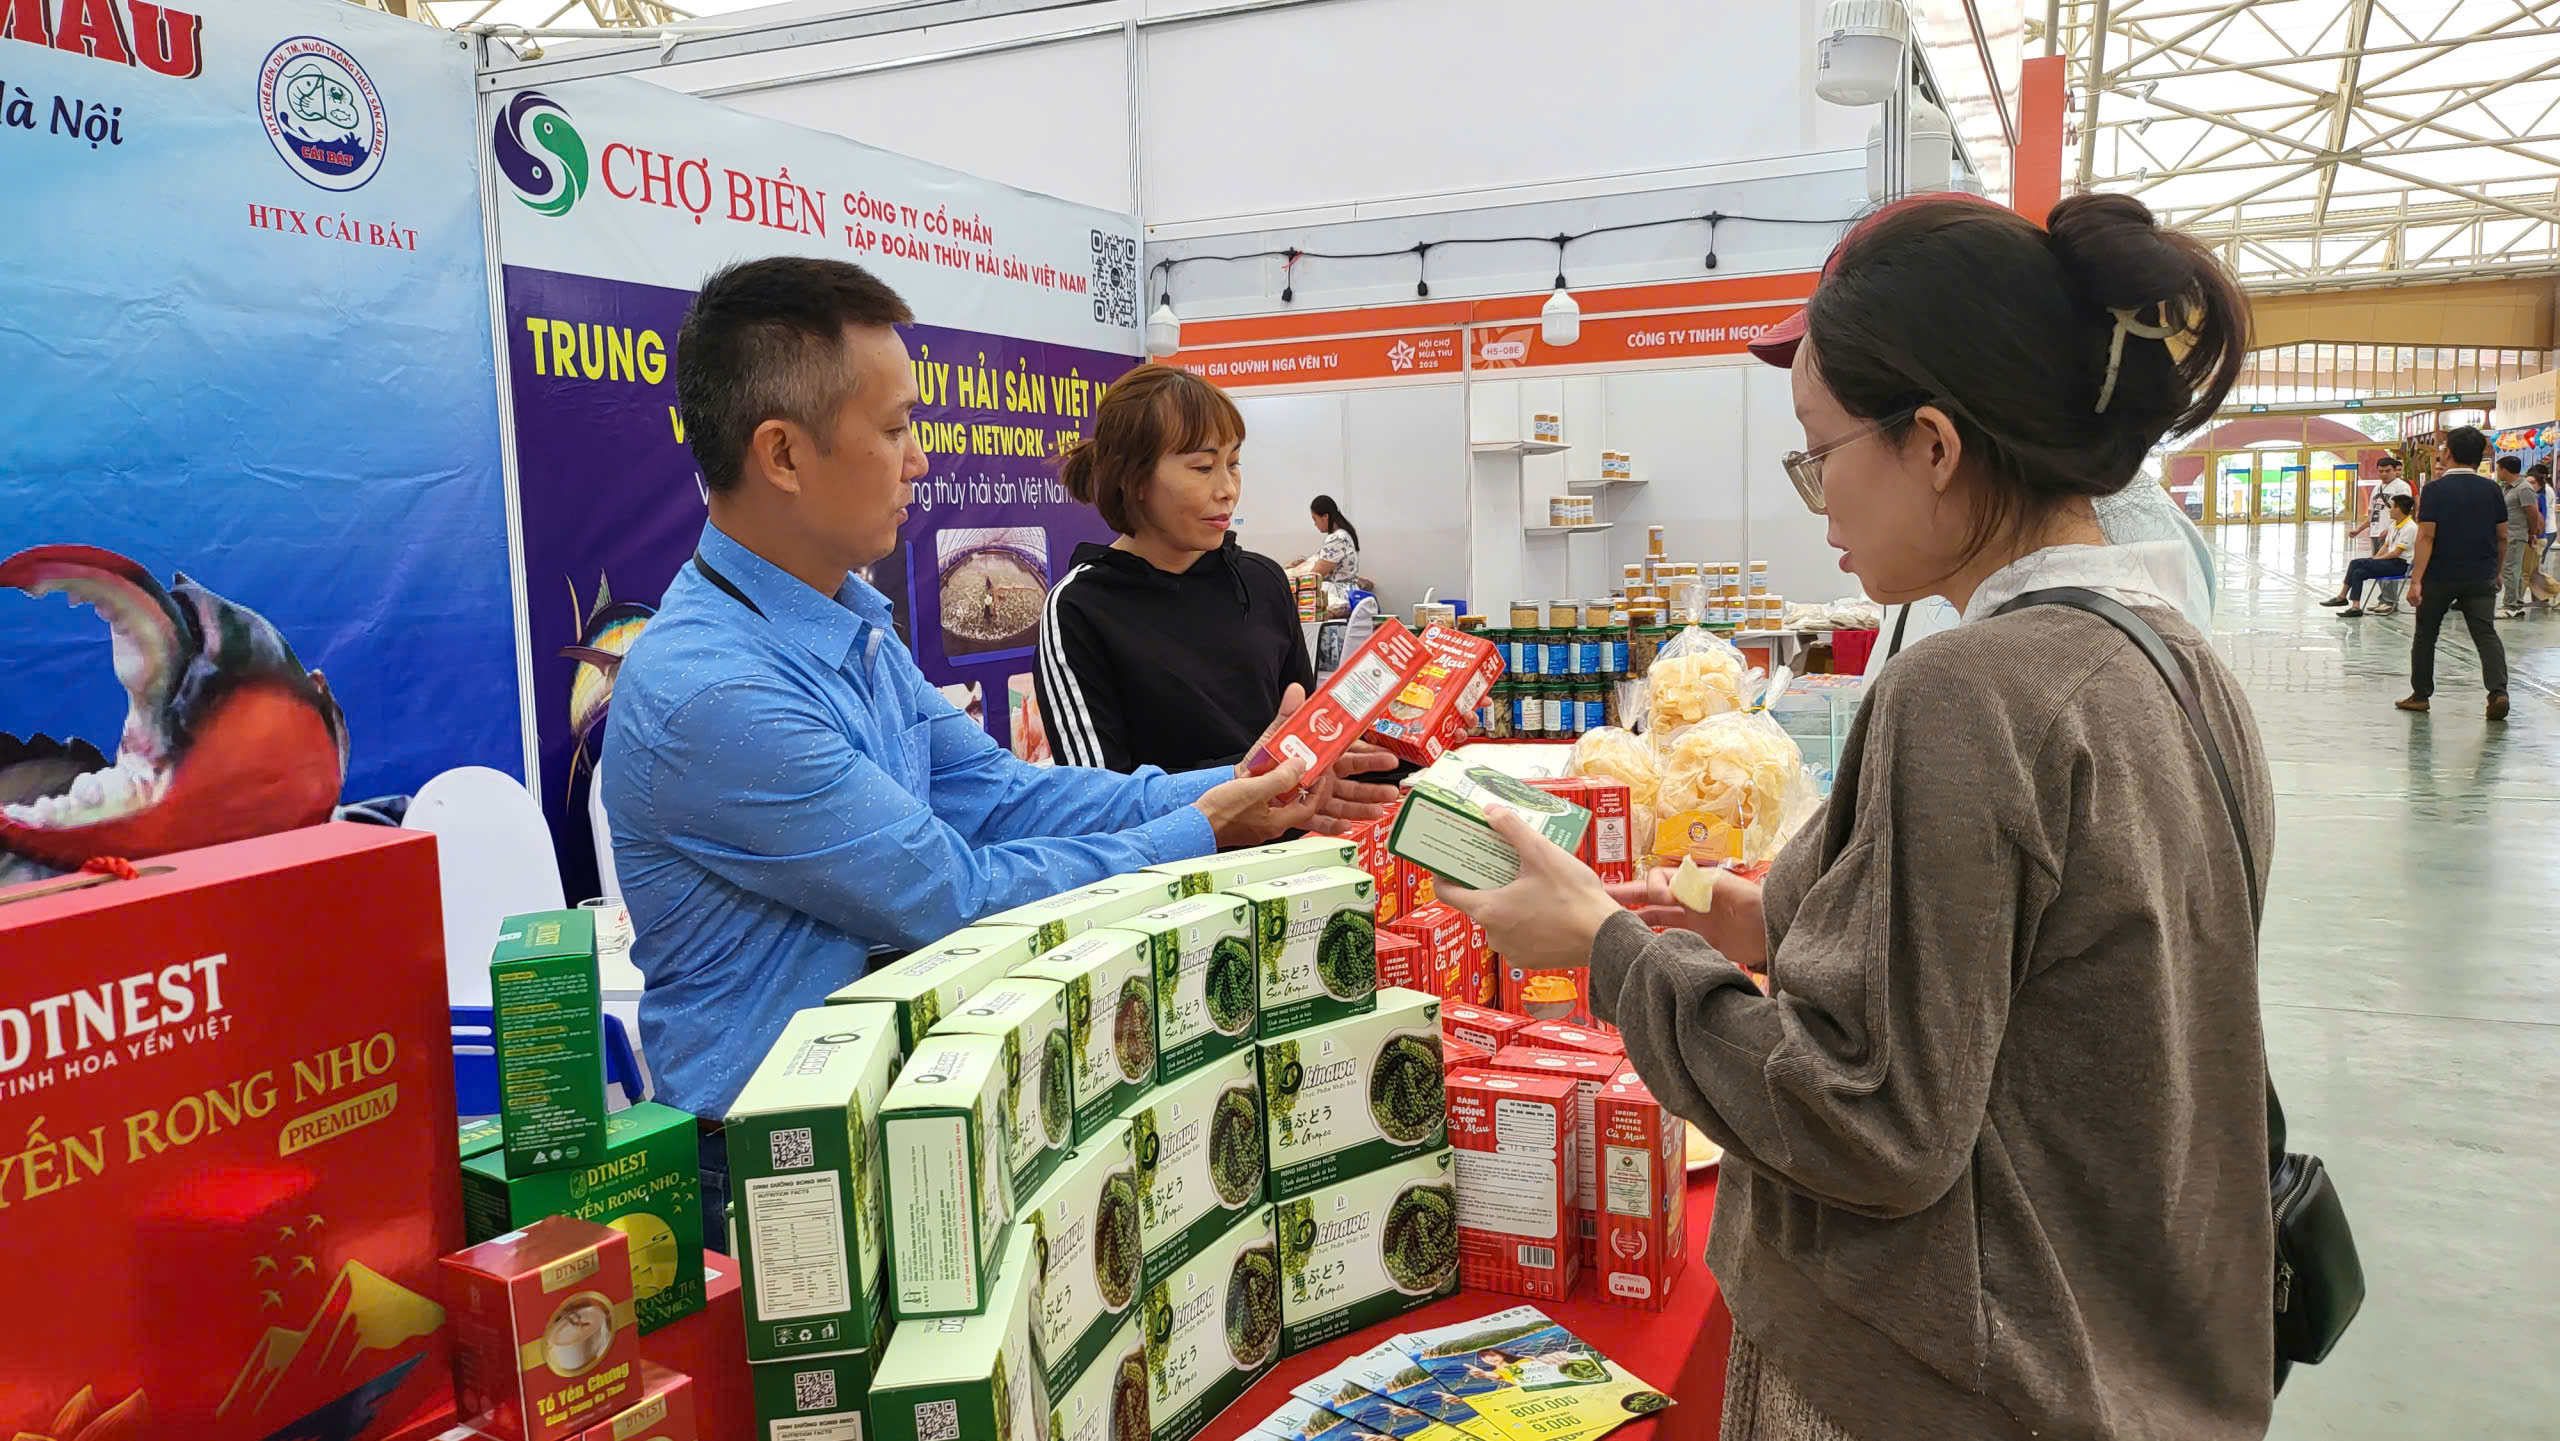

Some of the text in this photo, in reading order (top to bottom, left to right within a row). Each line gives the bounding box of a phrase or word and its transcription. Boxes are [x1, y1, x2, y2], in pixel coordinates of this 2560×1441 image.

[51, 96, 123, 149] Nội
[302, 145, 354, 167] CÁI BÁT
[601, 142, 826, 239] CHỢ BIỂN
[248, 203, 418, 252] HTX CÁI BÁT
[844, 191, 992, 246] CÔNG TY CỔ PHẦN
[845, 222, 1087, 295] TẬP ĐOÀN THỦY HẢI SẢN VIỆT NAM
[526, 317, 667, 384] TRUNG
[1418, 338, 1450, 350] HỘI CHỢ
[1418, 349, 1453, 358] MÙA THU
[1626, 330, 1666, 347] CÔNG
[1668, 329, 1686, 344] TY
[1688, 327, 1725, 343] TNHH
[1208, 362, 1228, 376] GAI
[1272, 358, 1296, 372] NGA
[958, 352, 999, 410] HẢI
[1005, 357, 1046, 414] SẢN
[1051, 368, 1089, 429] VIỆT
[971, 424, 1045, 458] NETWORK
[935, 472, 966, 510] thủy
[970, 472, 990, 504] hải
[994, 474, 1016, 504] sản
[1018, 478, 1042, 509] Việt
[1433, 654, 1468, 669] Mau
[1434, 945, 1465, 972] Cà Mau
[65, 1052, 118, 1081] HOA
[127, 1032, 174, 1061] YẾN
[184, 1014, 233, 1046] VIỆT
[1280, 1057, 1357, 1095] Okinawa
[123, 1070, 279, 1164] RONG
[292, 1032, 396, 1102] NHO
[286, 1096, 392, 1148] PREMIUM
[1278, 1104, 1332, 1134] 海ぶどう
[1446, 1118, 1490, 1134] Cà Mau
[1606, 1128, 1646, 1142] Cà Mau
[1141, 1118, 1199, 1170] Okinawa
[587, 1150, 648, 1186] DTNEST
[608, 1184, 647, 1210] RONG
[650, 1172, 680, 1193] NHO
[758, 1190, 789, 1198] NUTRITION
[1142, 1176, 1184, 1216] 海ぶどう
[1292, 1210, 1370, 1252] Okinawa
[555, 1254, 596, 1281] DTNEST
[1292, 1260, 1345, 1292] 海ぶどう
[1045, 1284, 1072, 1323] ぶどう
[1156, 1284, 1215, 1344] Okinawa
[1155, 1344, 1197, 1390] 海ぶどう
